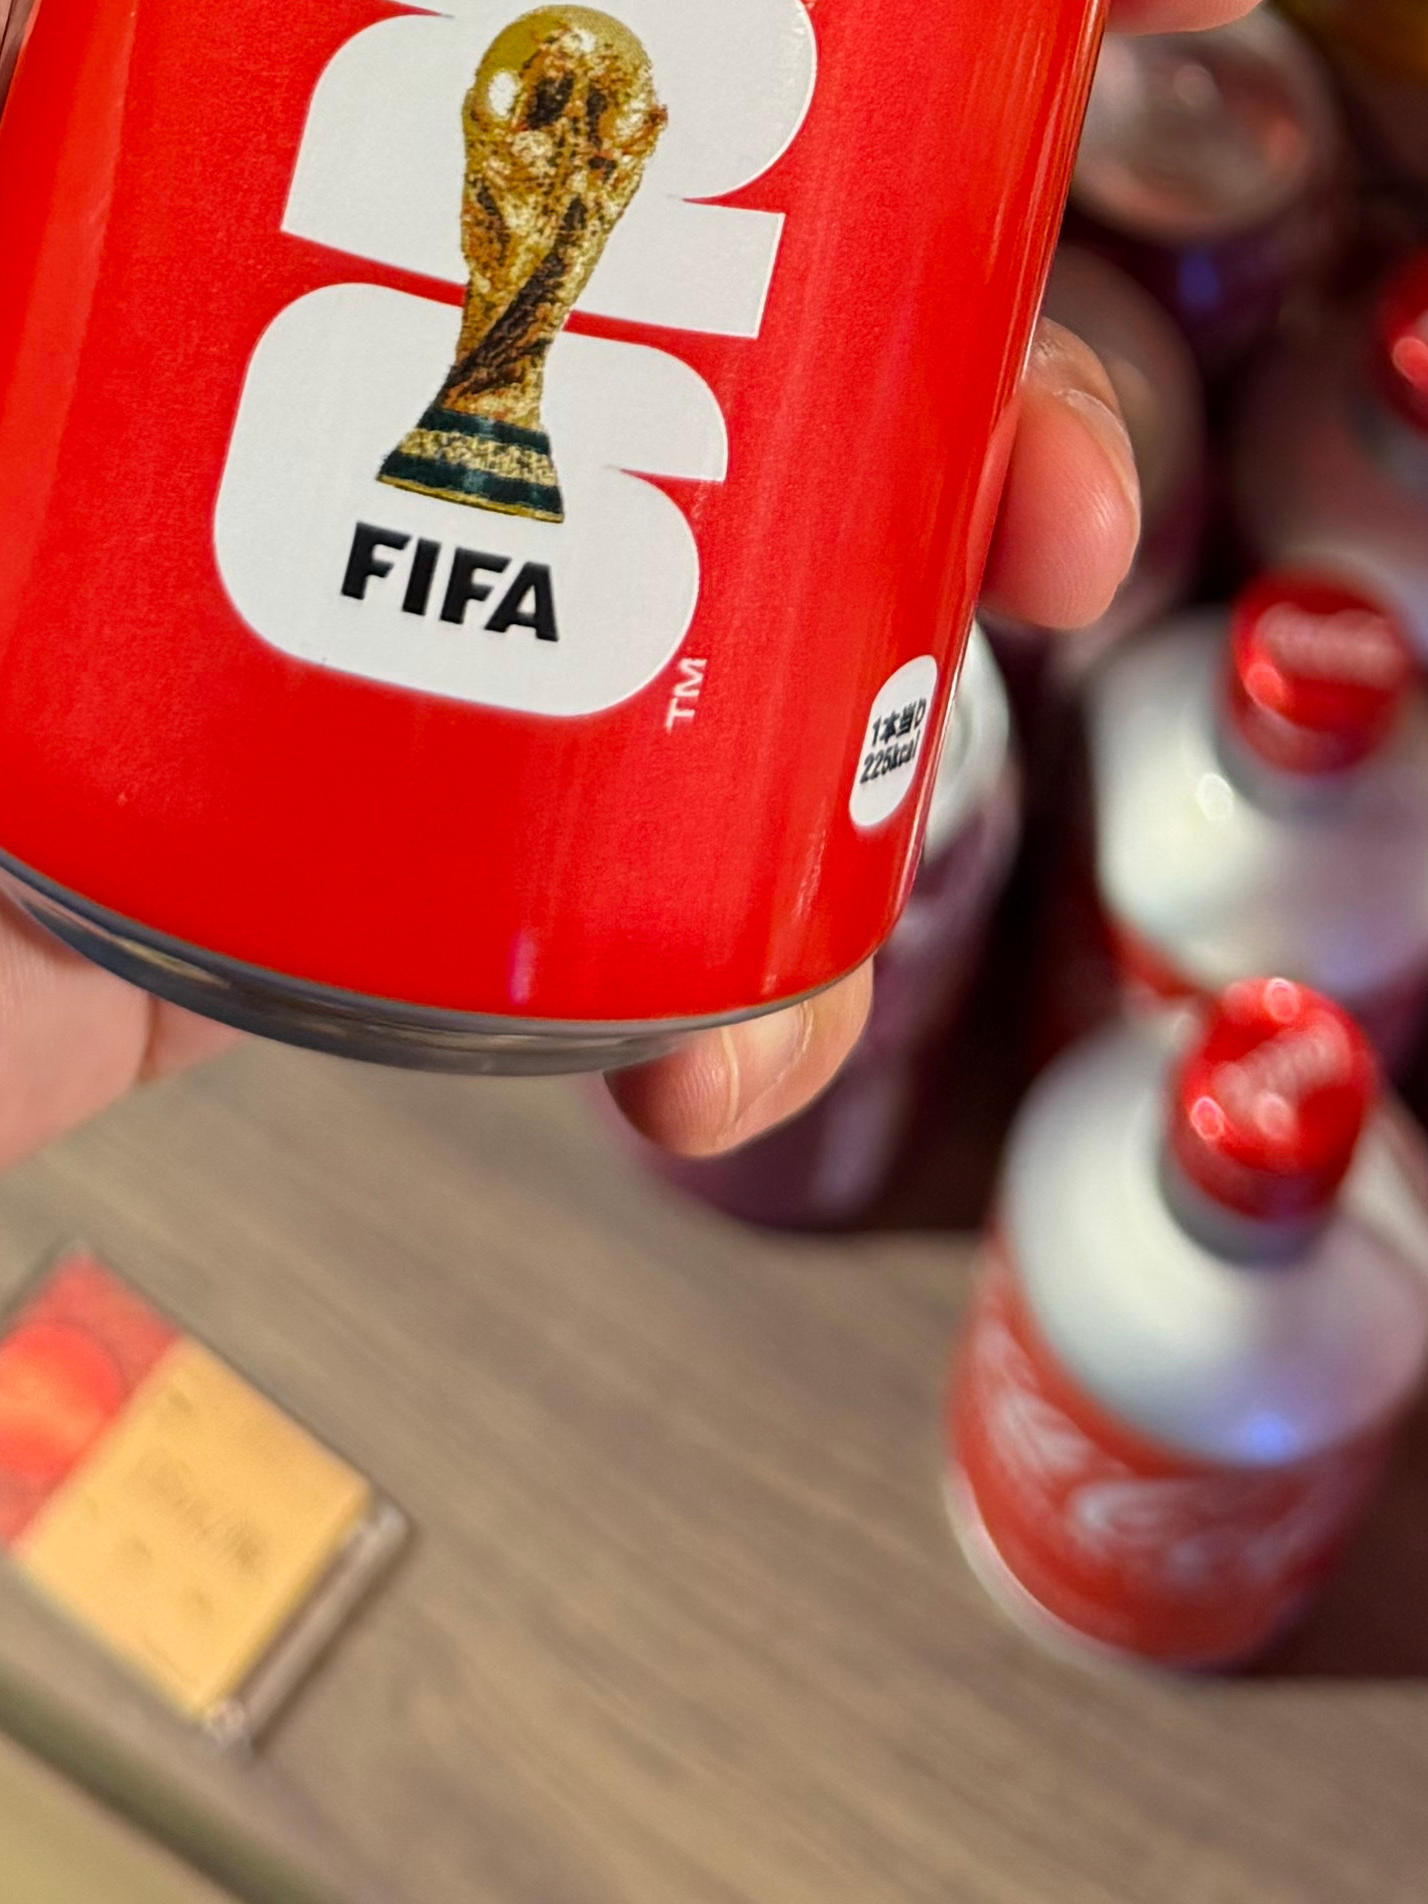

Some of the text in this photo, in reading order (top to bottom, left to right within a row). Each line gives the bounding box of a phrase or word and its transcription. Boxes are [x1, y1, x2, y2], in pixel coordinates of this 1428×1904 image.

[339, 519, 560, 643] FIFA
[664, 656, 708, 736] TM
[858, 729, 922, 785] 225kcal
